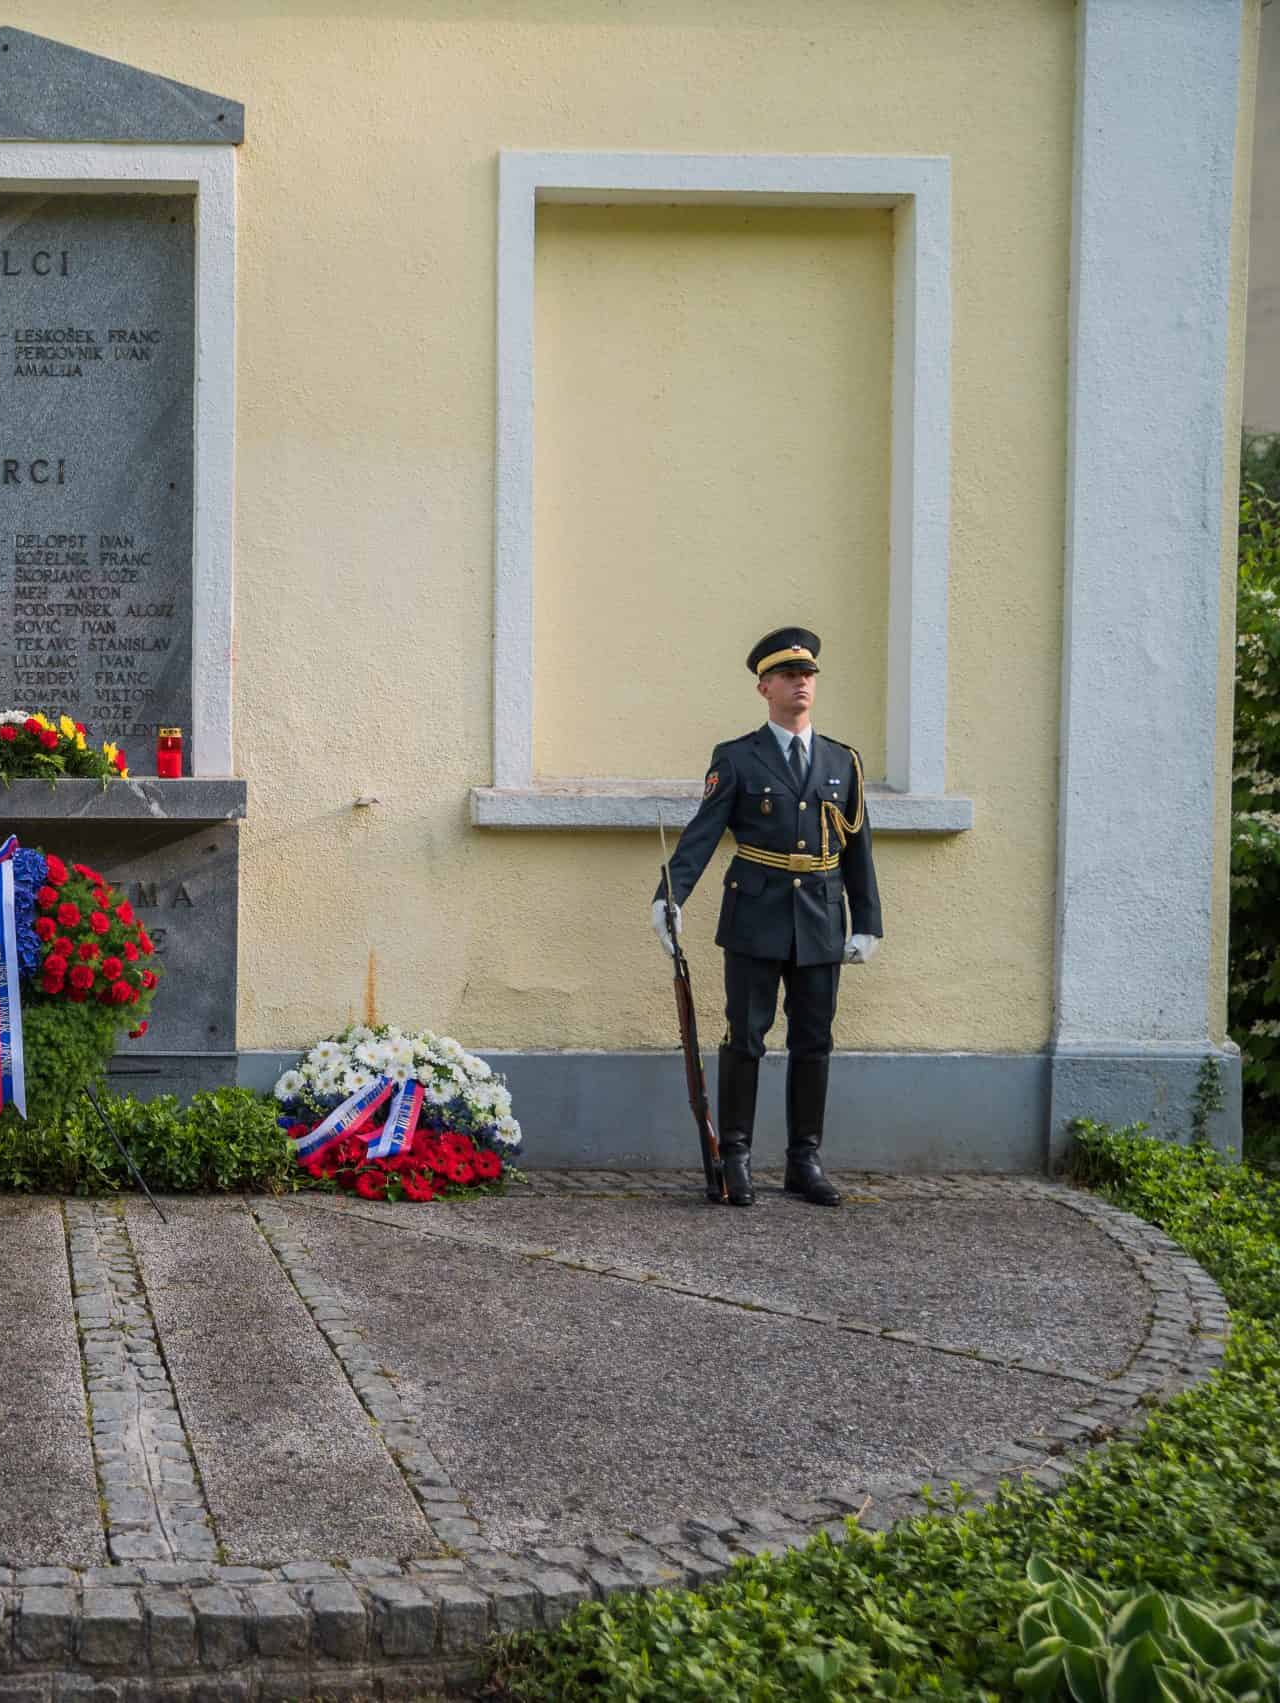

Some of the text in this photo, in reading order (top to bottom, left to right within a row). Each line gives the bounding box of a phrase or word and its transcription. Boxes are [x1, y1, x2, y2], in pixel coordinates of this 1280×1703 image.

[15, 327, 96, 343] LESKOŠEK
[108, 330, 160, 343] FRANC
[114, 346, 150, 360] IVAN
[15, 534, 87, 549] DELOPST
[99, 535, 135, 548] IVAN
[99, 552, 152, 566] FRANC
[102, 567, 138, 583] JOŽE
[15, 586, 48, 599] MEH
[65, 586, 120, 599] ANTON
[82, 621, 117, 634] IVAN
[87, 638, 171, 652] STANISLAV
[99, 655, 136, 668] IVAN
[94, 672, 148, 686] FRANC
